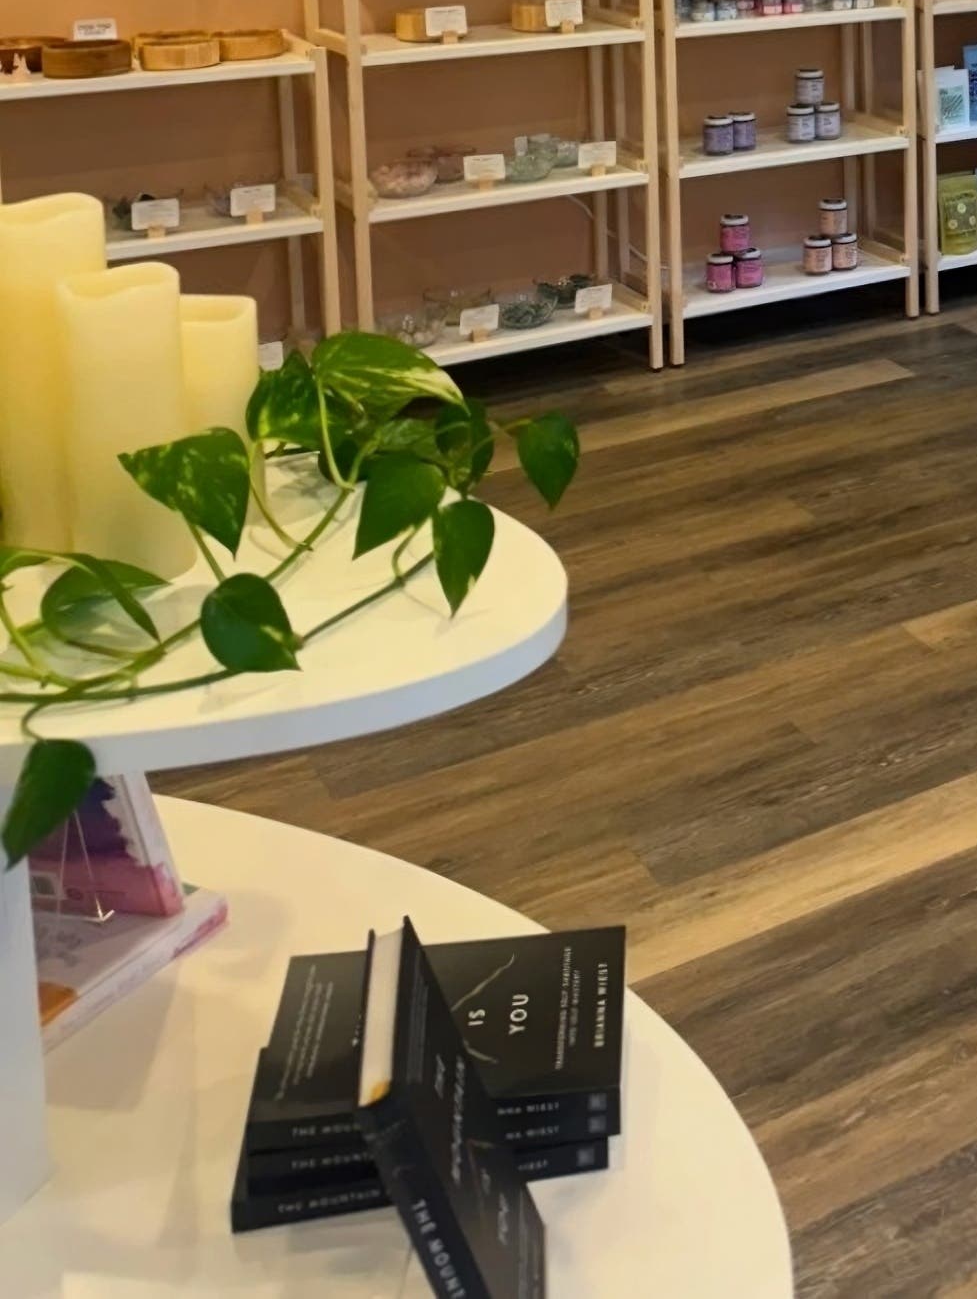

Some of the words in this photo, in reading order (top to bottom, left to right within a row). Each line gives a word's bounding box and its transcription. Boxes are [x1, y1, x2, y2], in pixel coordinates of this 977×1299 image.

[468, 1009, 486, 1026] IS
[508, 994, 529, 1035] YOU
[411, 1198, 437, 1235] THE
